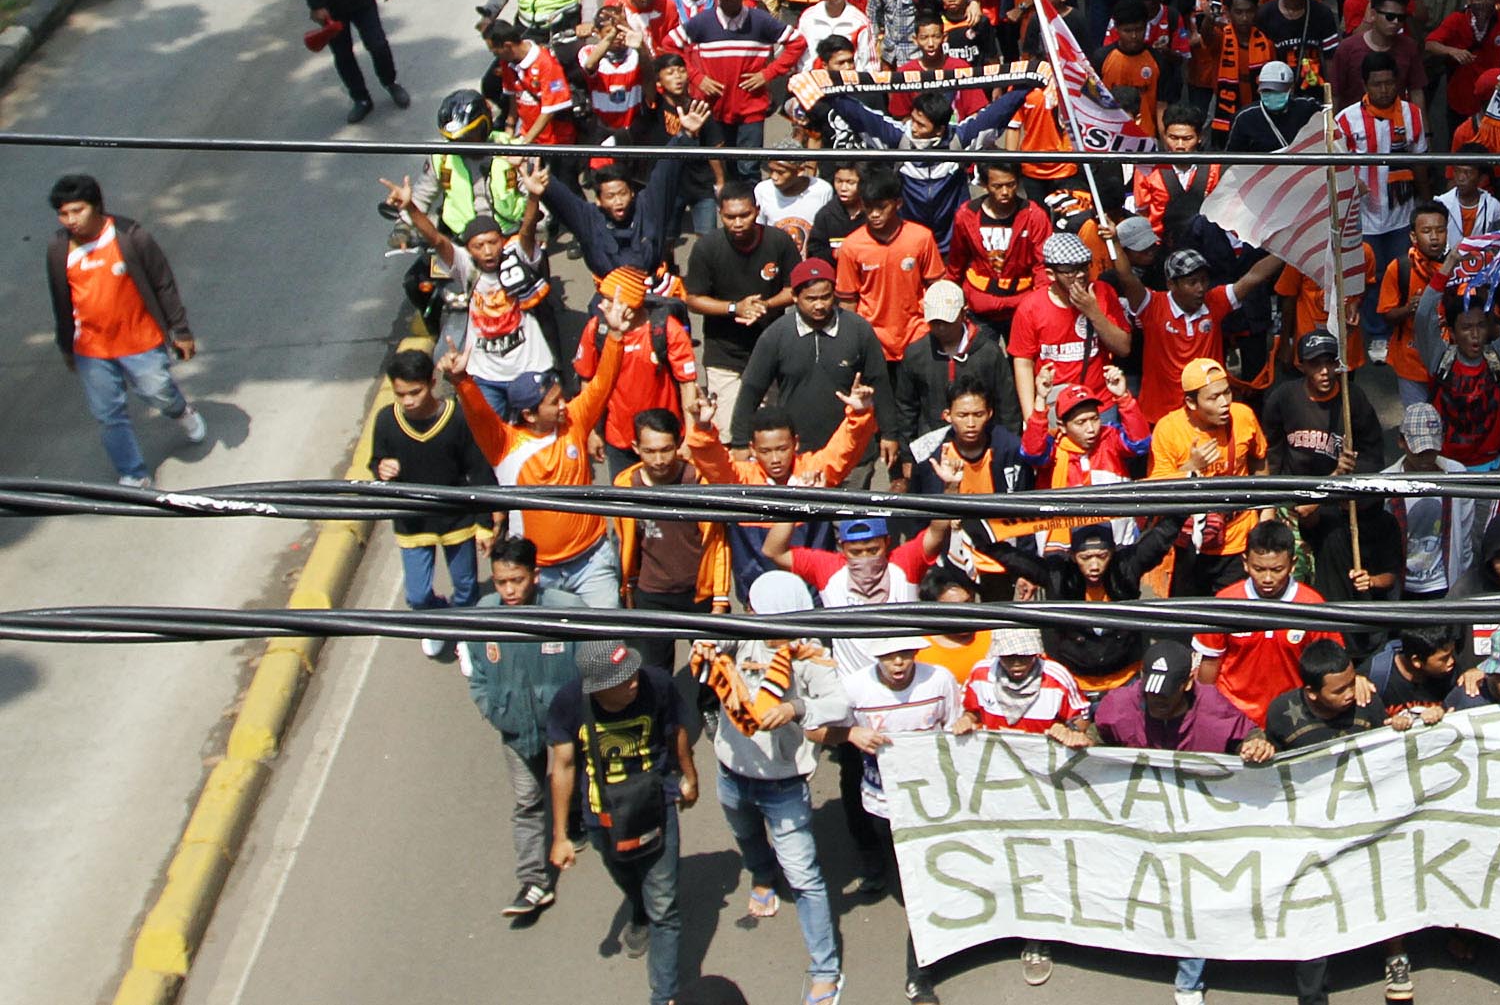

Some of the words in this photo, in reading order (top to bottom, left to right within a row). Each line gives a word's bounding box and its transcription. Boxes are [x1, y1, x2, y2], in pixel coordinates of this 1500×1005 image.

[942, 41, 980, 60] Persija
[923, 78, 956, 89] DAPAT
[896, 733, 1384, 826] JAKARTA
